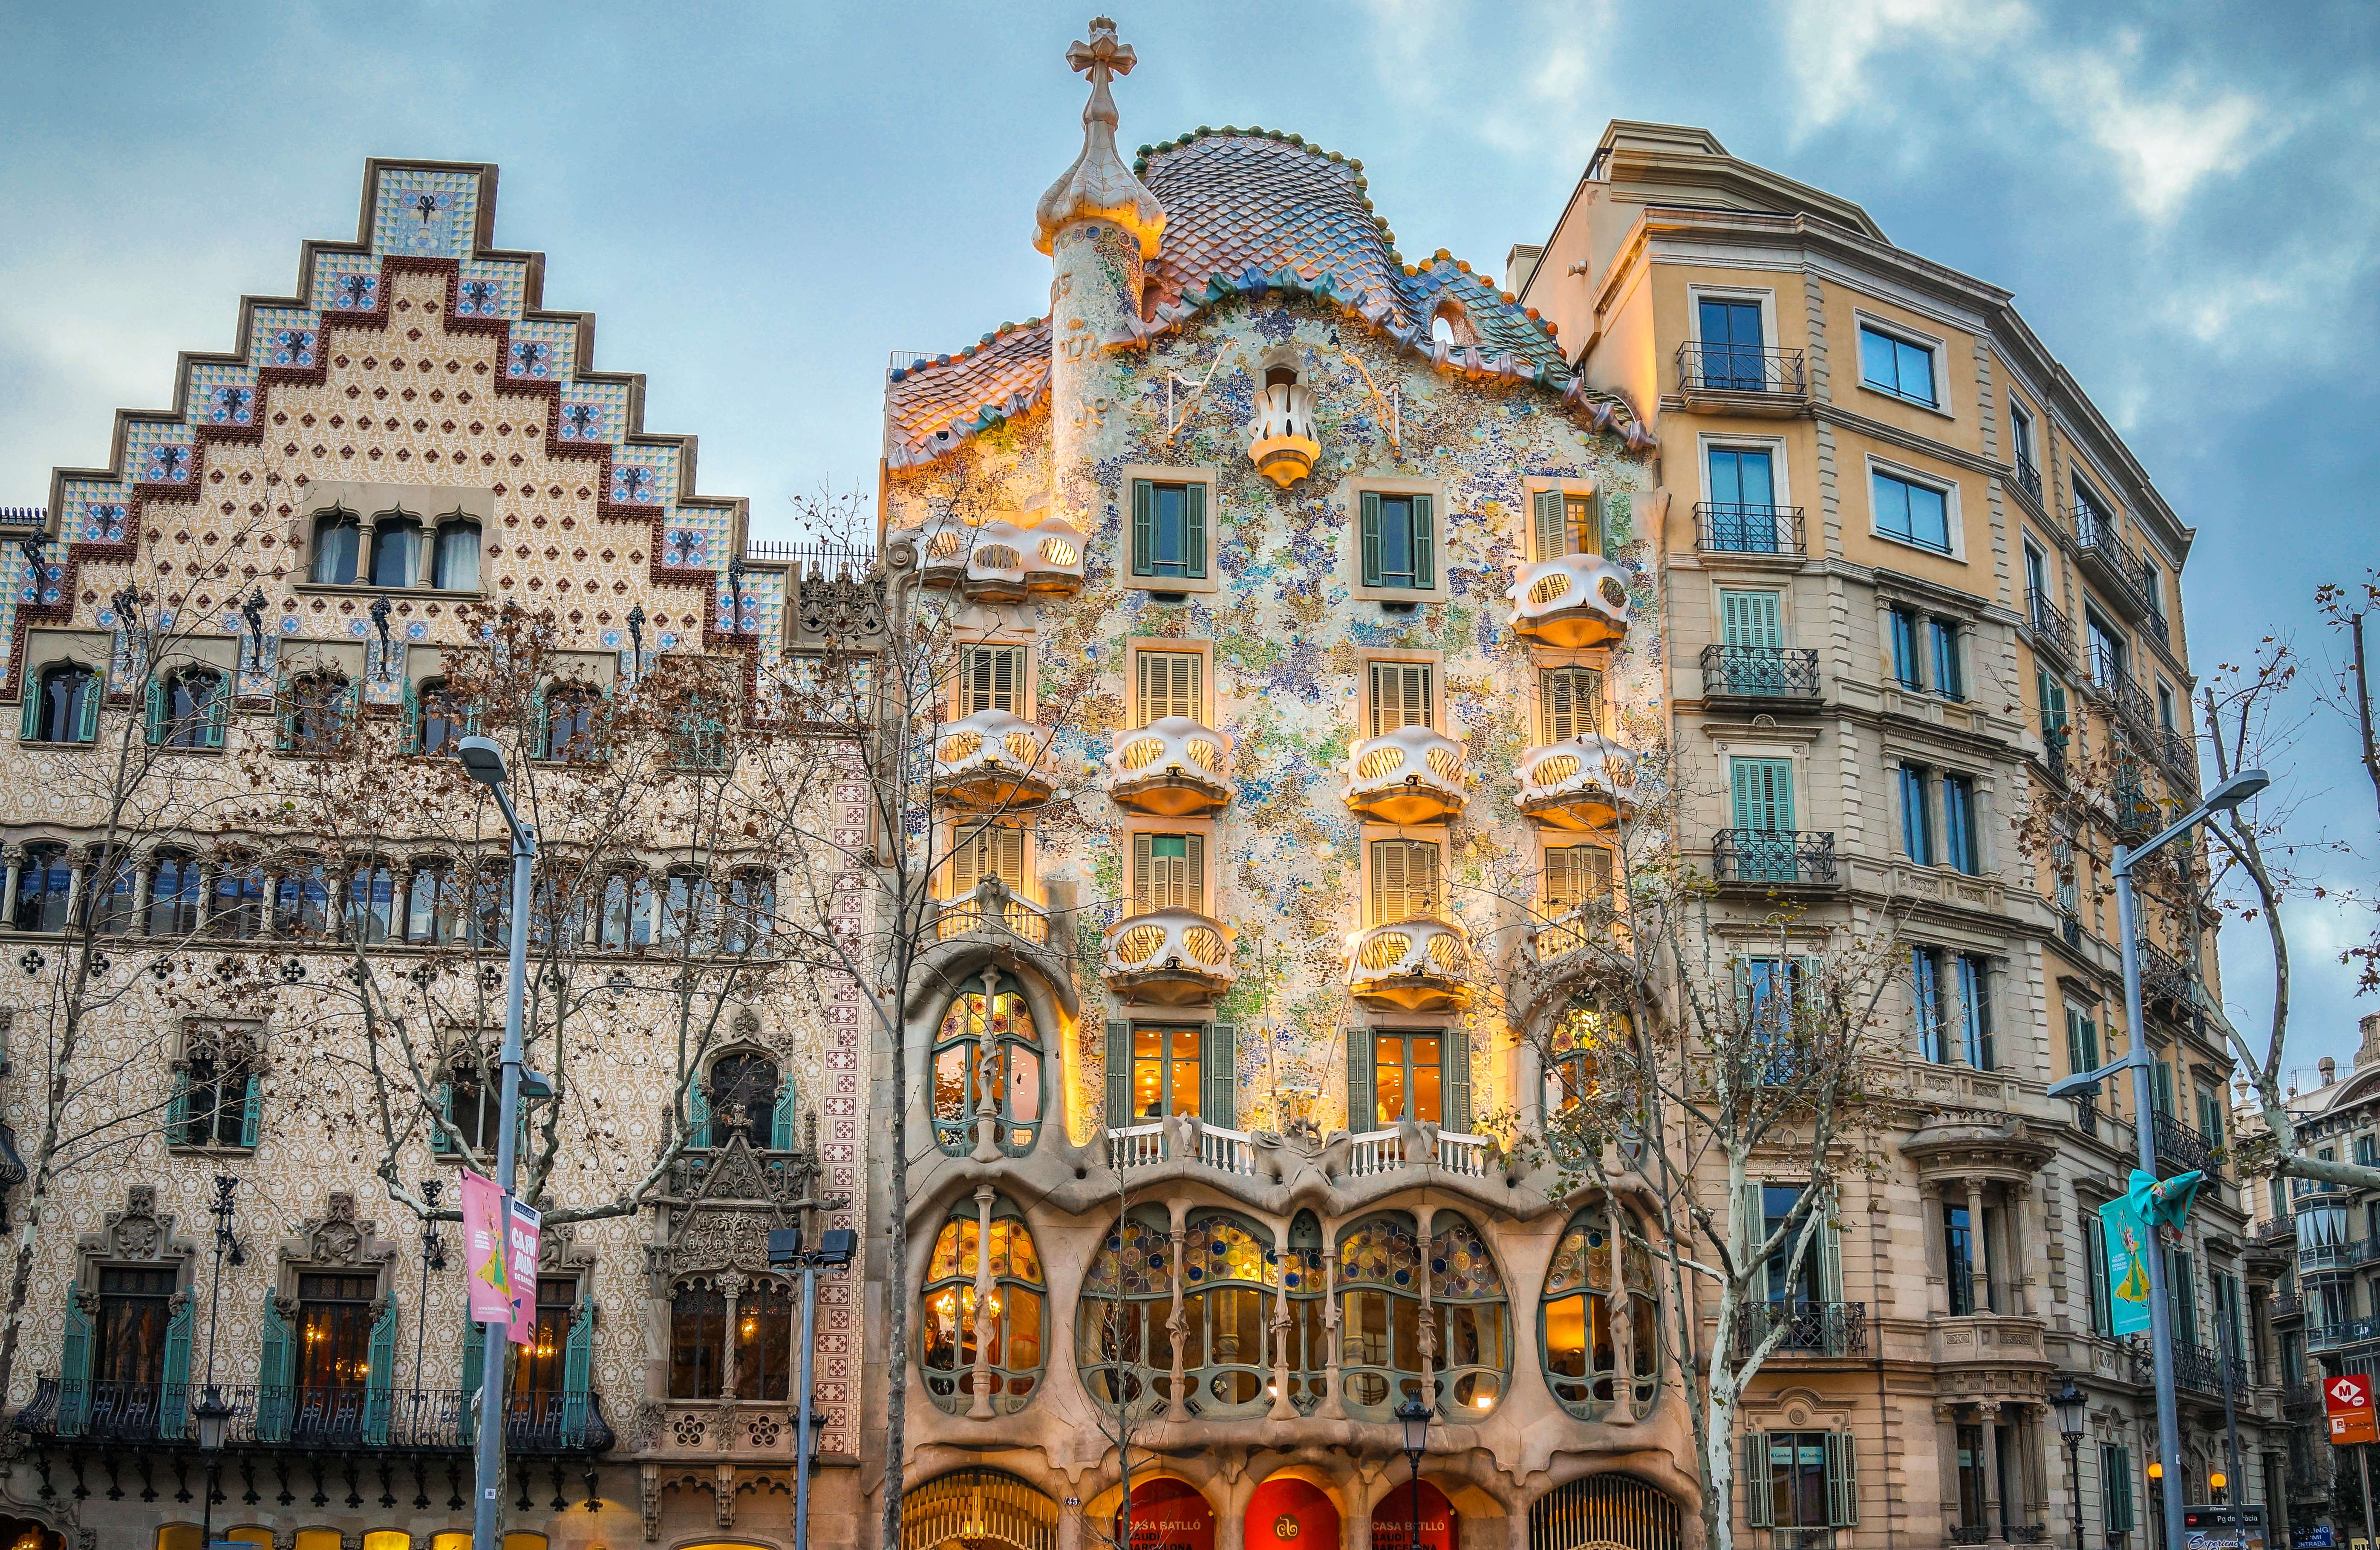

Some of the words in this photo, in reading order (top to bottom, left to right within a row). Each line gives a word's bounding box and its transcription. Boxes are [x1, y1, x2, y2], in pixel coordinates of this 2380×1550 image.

[2338, 1385, 2351, 1397] M
[1129, 1521, 1156, 1530] CASA
[1160, 1519, 1201, 1530] BATLLÓ
[1372, 1521, 1401, 1530] CASA
[1405, 1519, 1445, 1530] BTLLÓ
[2189, 1535, 2238, 1550] Experienc
